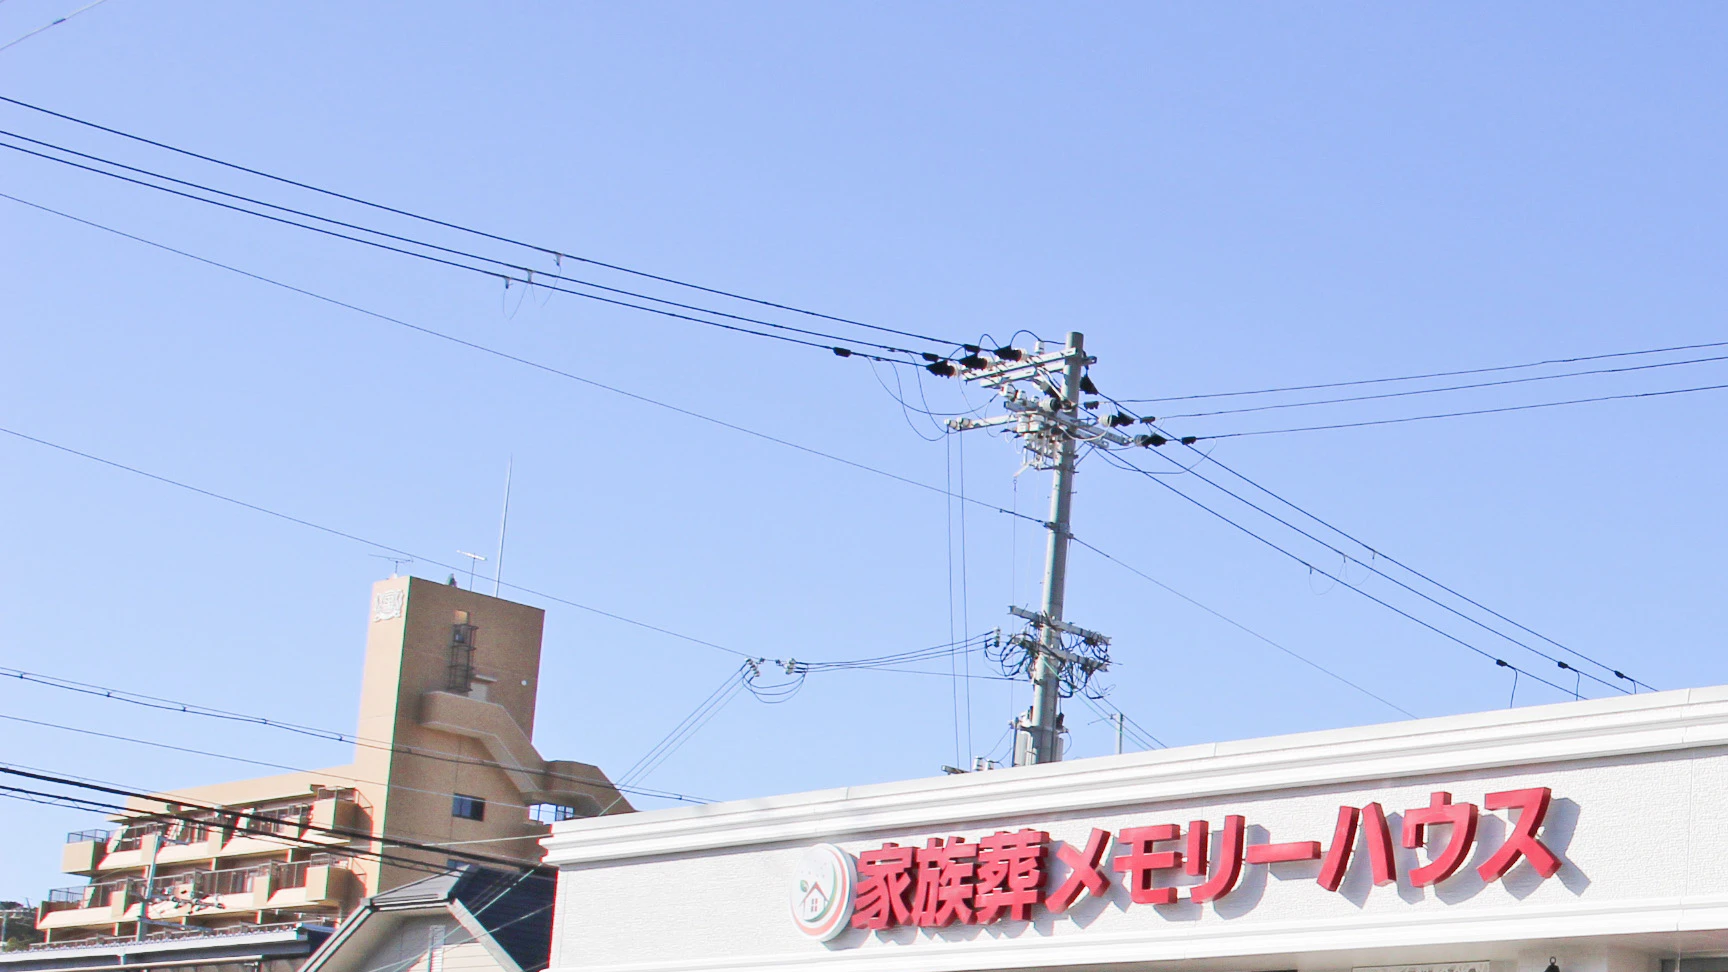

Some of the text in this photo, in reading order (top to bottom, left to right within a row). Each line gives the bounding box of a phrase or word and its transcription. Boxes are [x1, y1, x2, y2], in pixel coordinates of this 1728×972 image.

[851, 787, 1563, 931] 家族葬メモリーハウス
